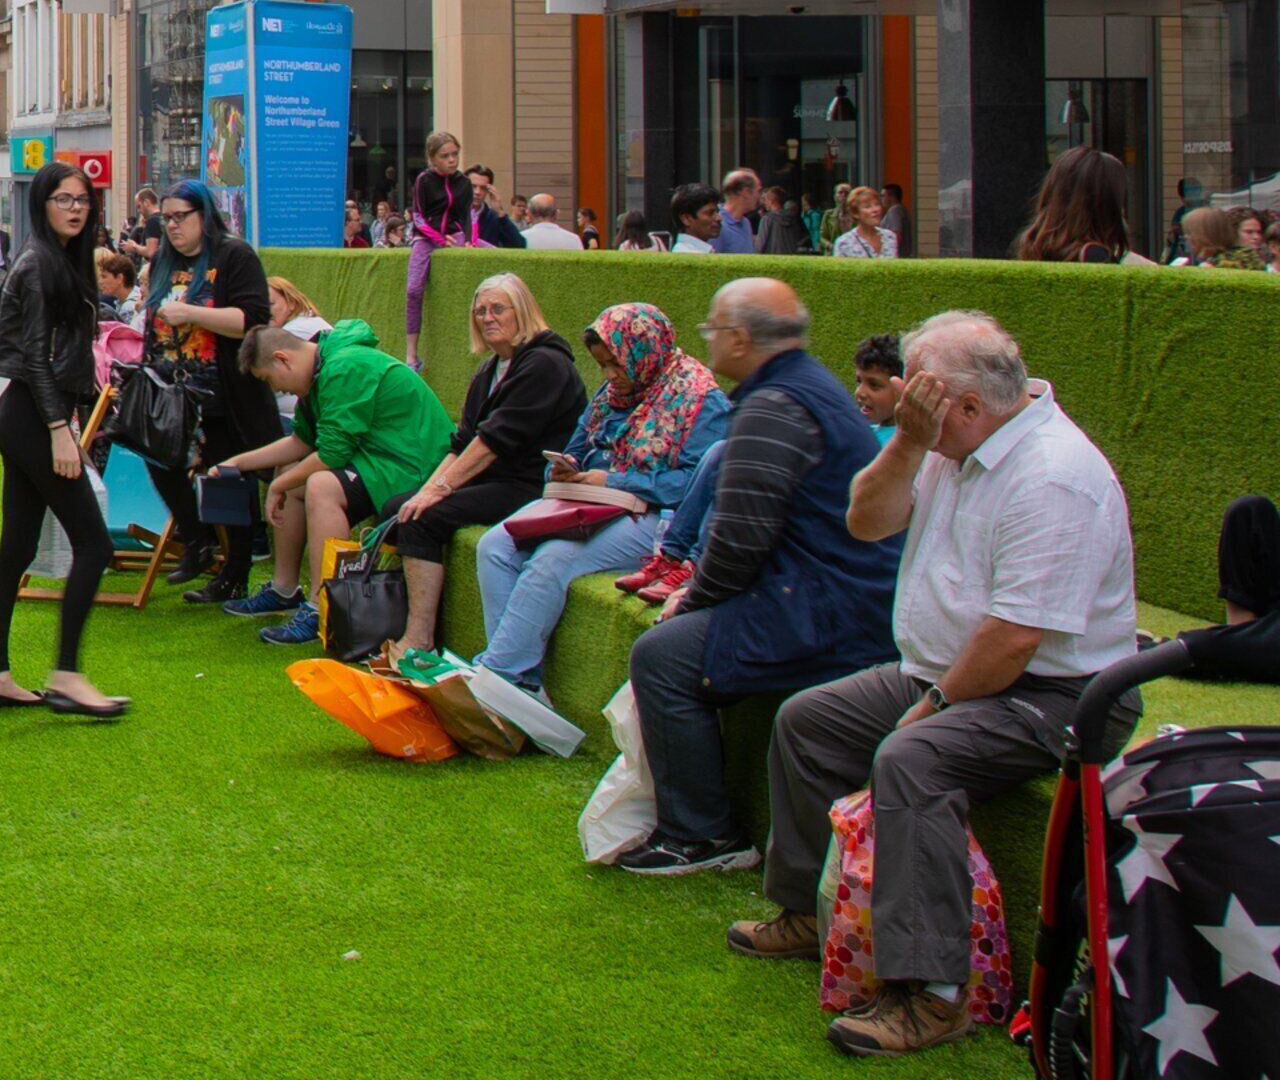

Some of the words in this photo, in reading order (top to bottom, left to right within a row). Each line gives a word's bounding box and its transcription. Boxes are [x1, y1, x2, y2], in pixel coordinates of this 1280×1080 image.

[262, 17, 282, 32] NE1
[264, 60, 340, 72] NORTHUMBERLAND
[264, 72, 294, 81] STREET
[264, 95, 300, 104] Welcome
[301, 96, 309, 105] to
[265, 106, 326, 116] Northumberland
[265, 117, 288, 126] Street
[290, 117, 316, 128] Village
[317, 118, 339, 128] Green
